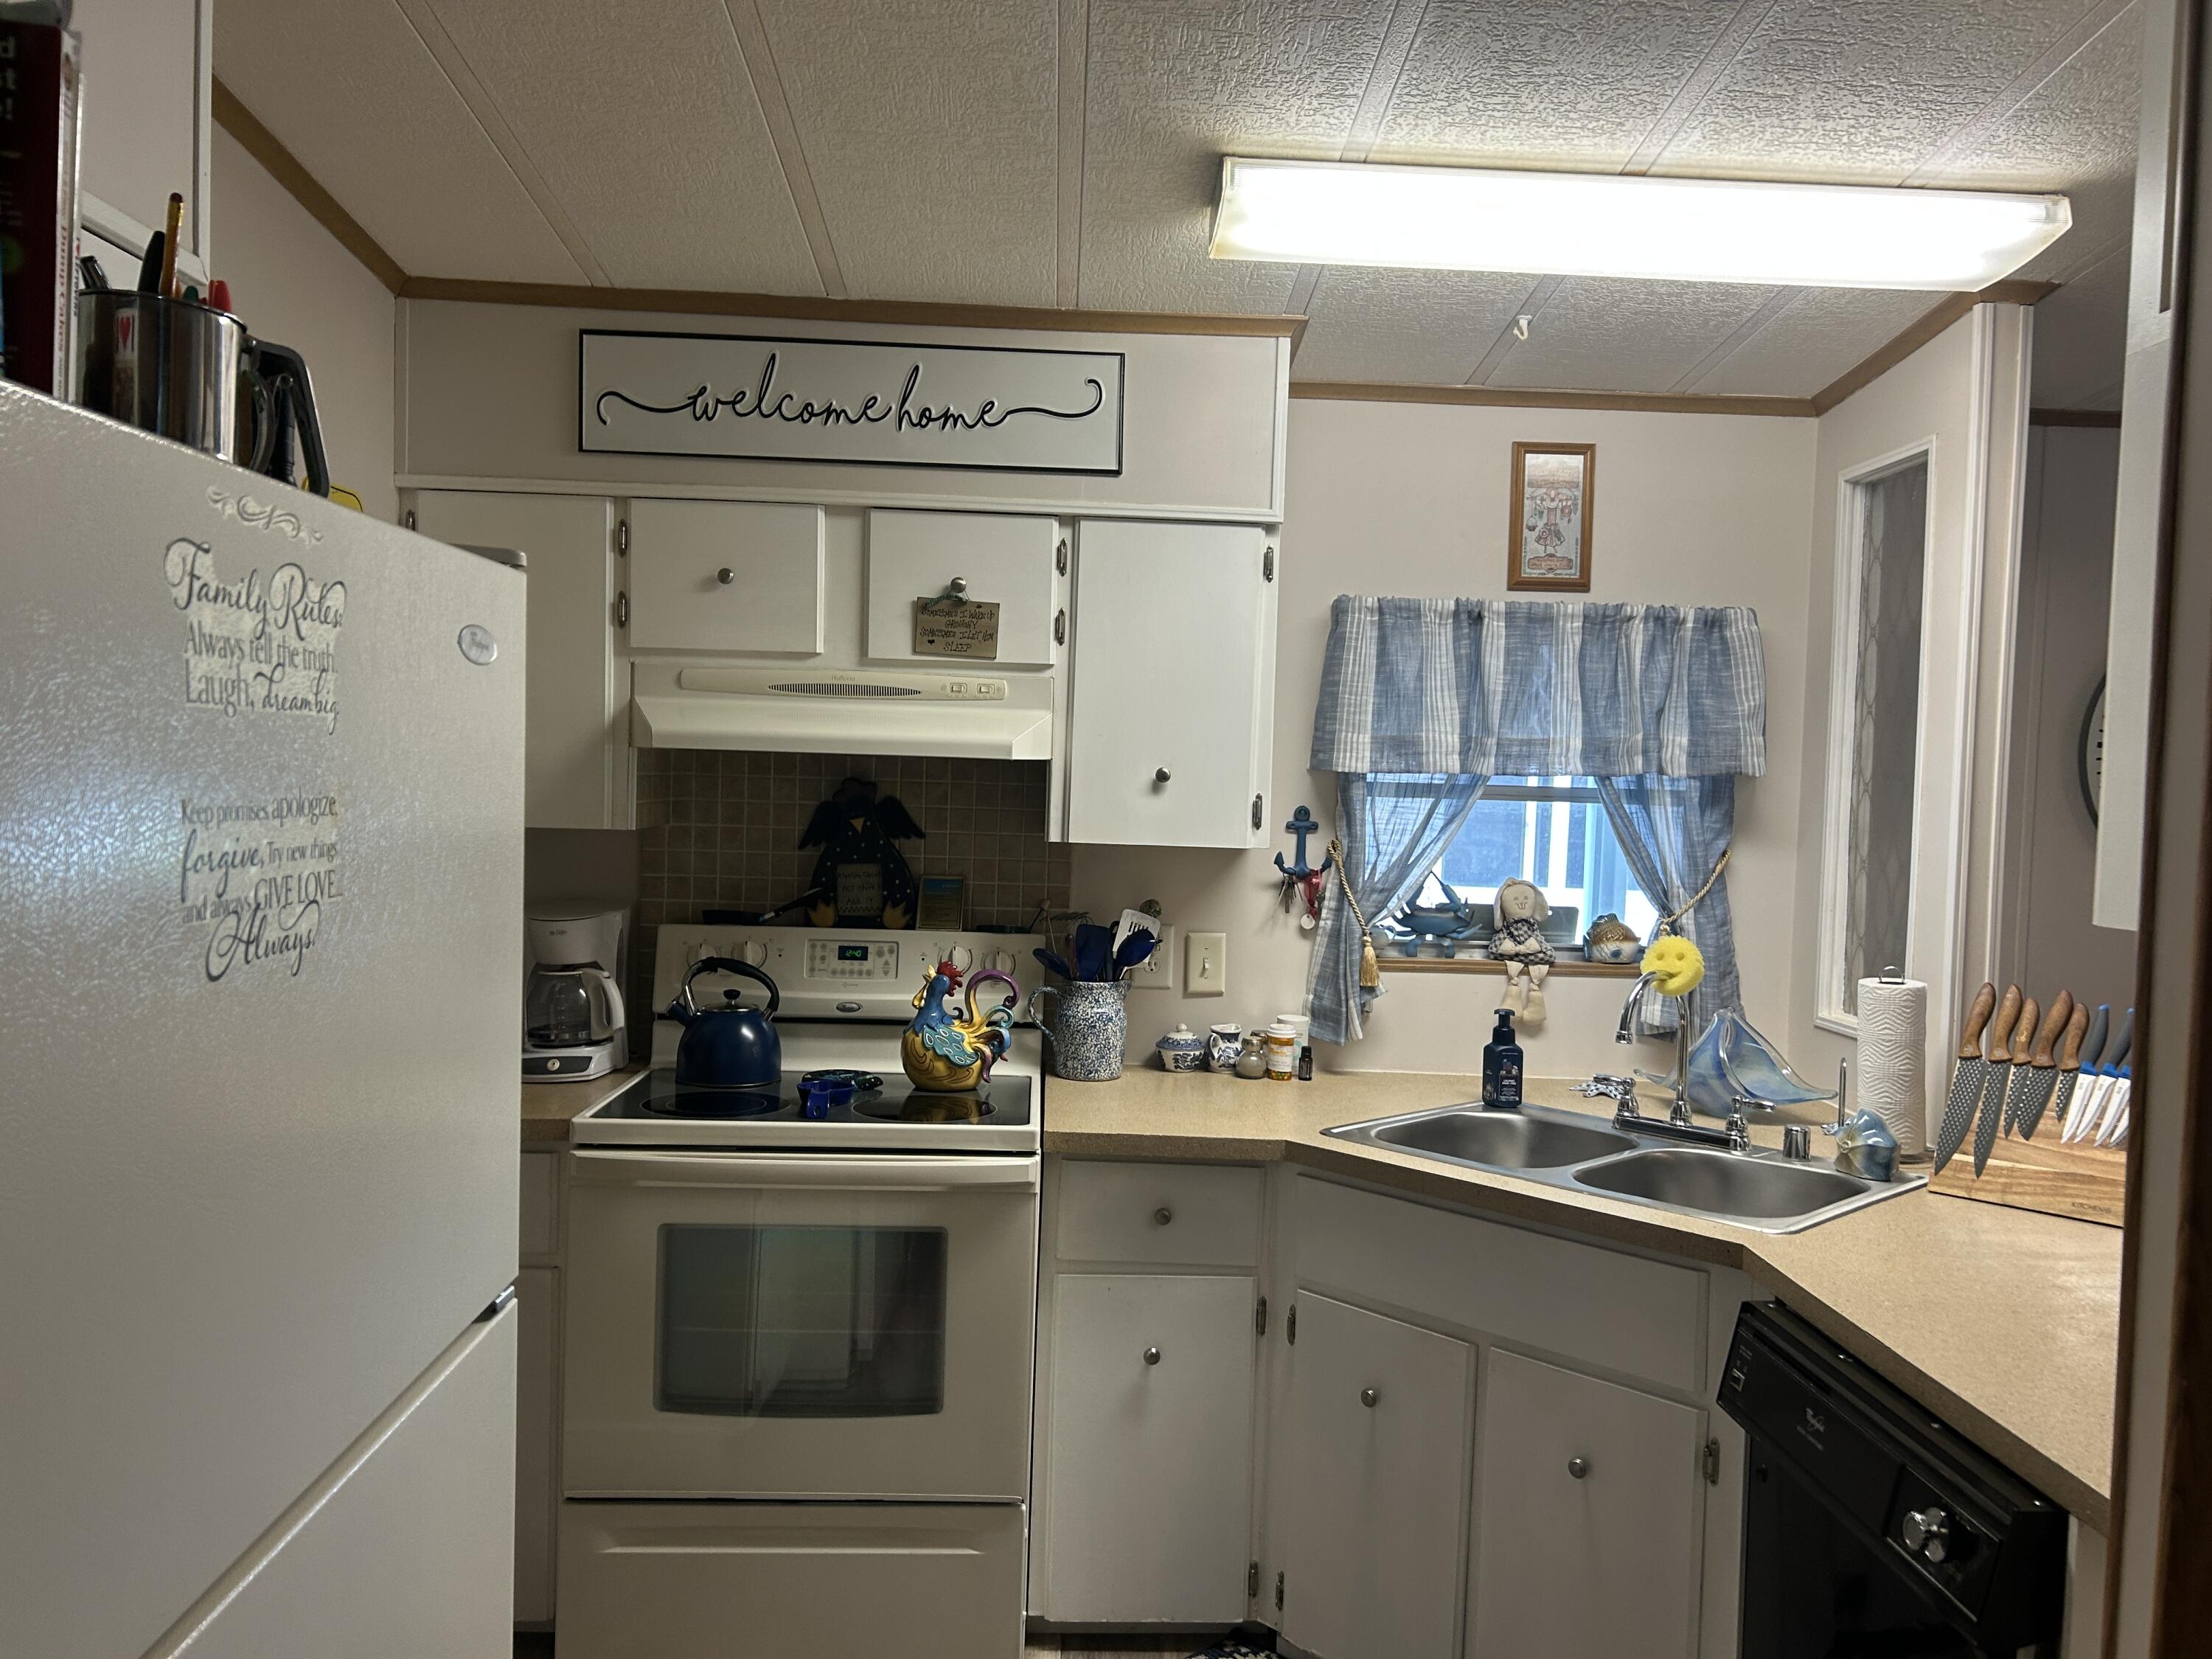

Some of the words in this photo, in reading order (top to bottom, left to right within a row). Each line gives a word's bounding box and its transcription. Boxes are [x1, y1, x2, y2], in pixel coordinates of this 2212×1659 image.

[58, 291, 66, 352] Cakes
[682, 351, 893, 425] welcome
[897, 362, 1018, 431] home
[164, 538, 268, 641] Family
[921, 608, 958, 619] SOMETIMES
[959, 609, 968, 619] I
[969, 609, 987, 620] WAKE
[987, 610, 995, 621] UP
[945, 619, 978, 630] GROUCHY
[184, 620, 245, 669] Always
[250, 631, 273, 664] tell
[276, 634, 299, 669] the
[919, 627, 956, 639] SOMETIMES
[959, 631, 967, 639] I
[967, 630, 982, 640] LET
[982, 630, 995, 642] HIM
[943, 641, 972, 653] SLEEP
[185, 658, 254, 718] Laugh,
[181, 799, 214, 830] Keep
[266, 841, 282, 869] Try
[285, 846, 306, 862] new
[254, 874, 293, 910] GIVE
